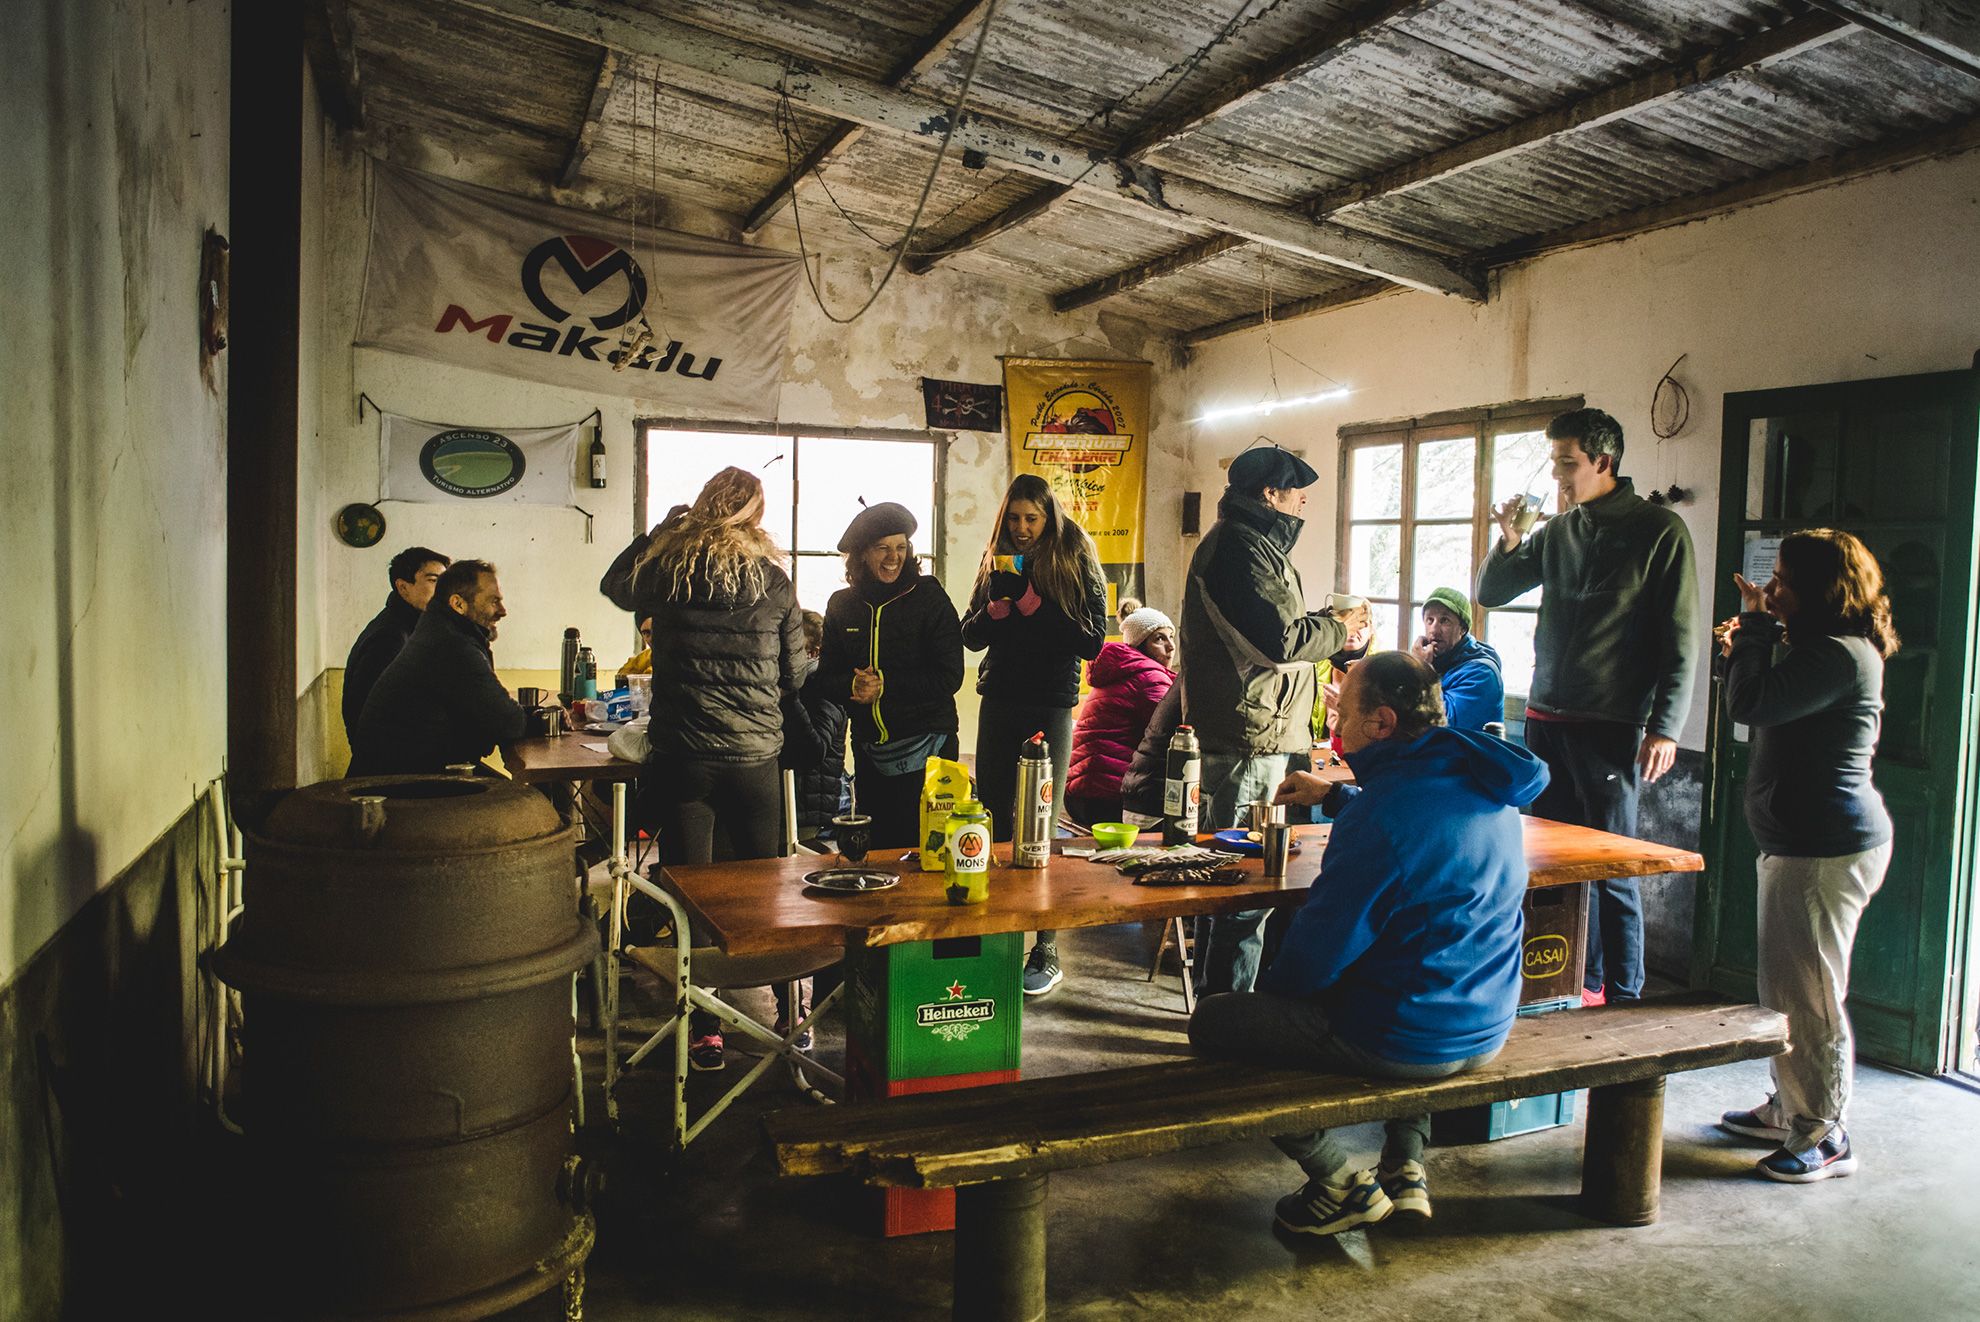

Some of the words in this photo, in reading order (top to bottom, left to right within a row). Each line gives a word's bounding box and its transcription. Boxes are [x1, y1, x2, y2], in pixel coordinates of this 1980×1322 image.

[435, 304, 722, 381] Makalu
[1112, 405, 1126, 428] 2007
[440, 432, 490, 444] ASCENSO
[492, 436, 508, 448] 23
[1029, 434, 1126, 449] ADVENTURE
[1040, 451, 1117, 463] CHALLENGE
[432, 475, 464, 494] TURISMO
[466, 477, 515, 495] ALTERNATIVO
[956, 858, 985, 868] MONS
[923, 1005, 989, 1021] Heineken
